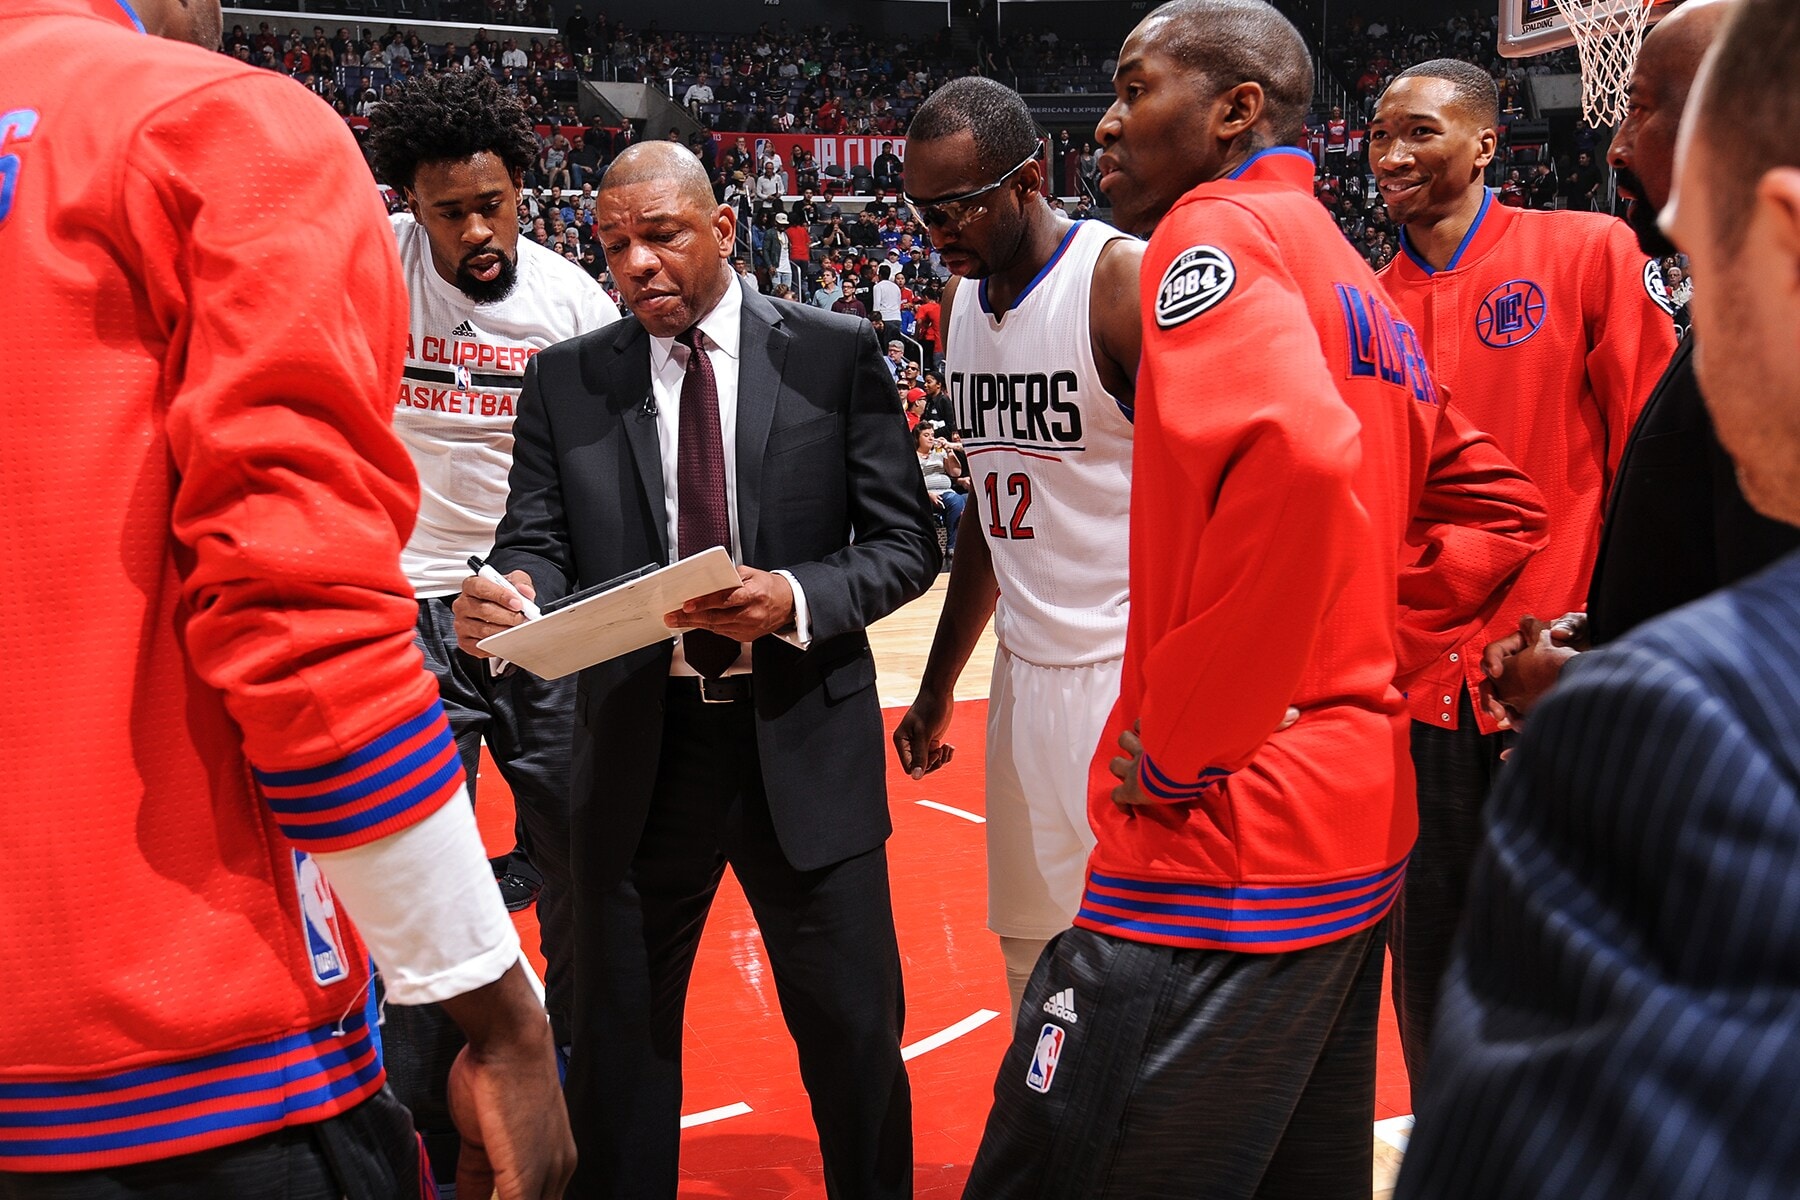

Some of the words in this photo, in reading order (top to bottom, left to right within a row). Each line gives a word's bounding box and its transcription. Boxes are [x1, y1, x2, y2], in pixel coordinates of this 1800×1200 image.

[1522, 18, 1553, 35] SPALDING
[1164, 265, 1218, 309] 1984
[451, 329, 477, 338] adidas
[951, 370, 1083, 442] CLIPPERS
[984, 472, 1035, 540] 12
[1043, 1001, 1078, 1024] adidas
